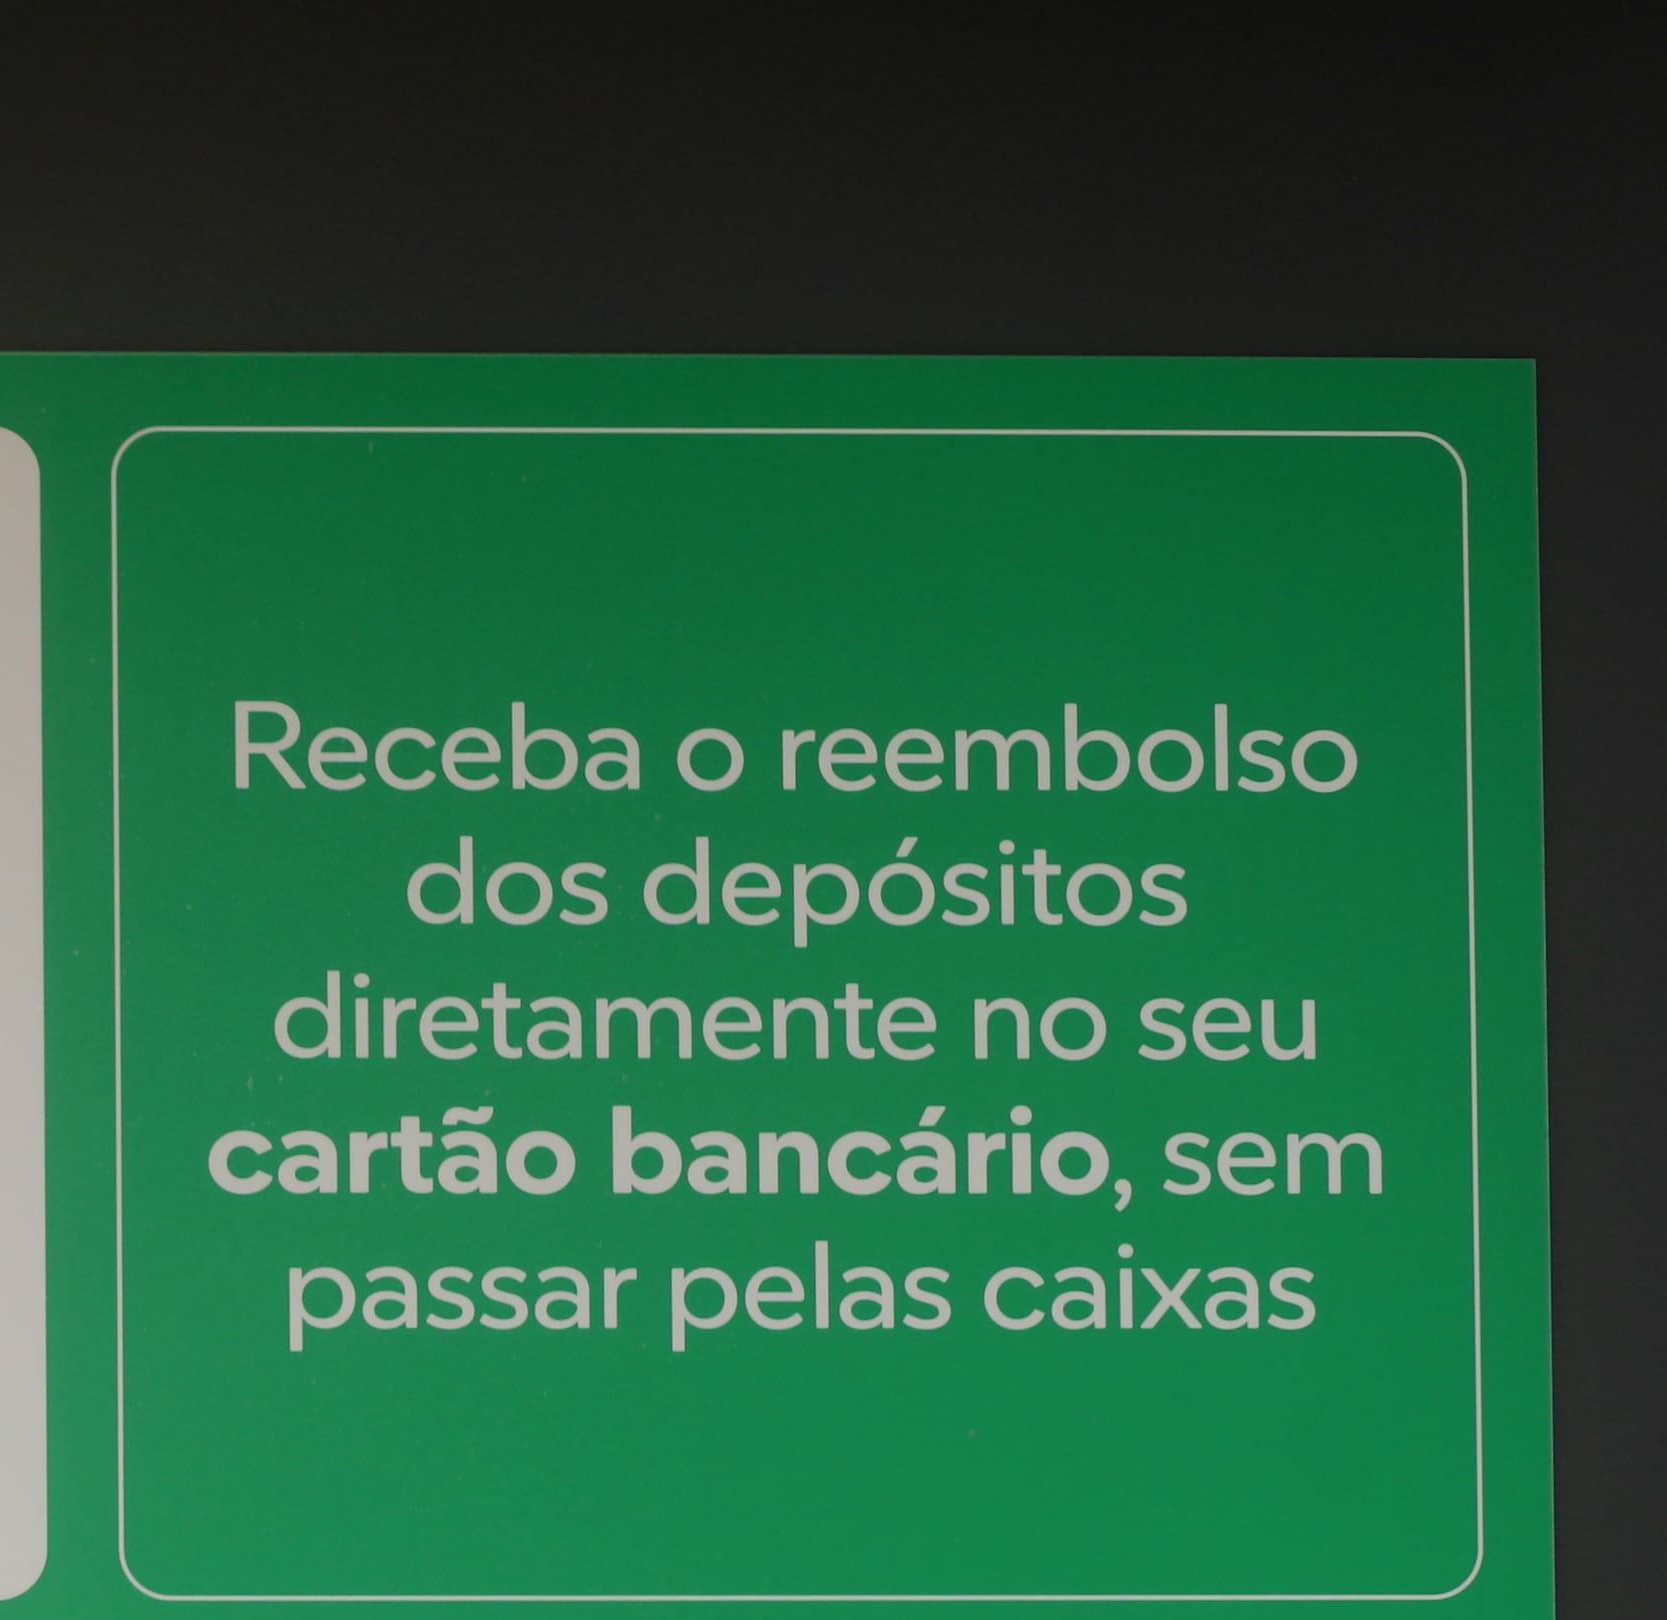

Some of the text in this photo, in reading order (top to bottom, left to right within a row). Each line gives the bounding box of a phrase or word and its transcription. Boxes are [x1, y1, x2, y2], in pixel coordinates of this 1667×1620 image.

[234, 700, 1358, 793] Receba o reembolso
[406, 835, 1188, 948] dos depósitos
[274, 969, 1317, 1062] diretamente no seu
[208, 1105, 1383, 1212] cartão bancário, sem
[288, 1240, 1316, 1353] passar pelas caixas
